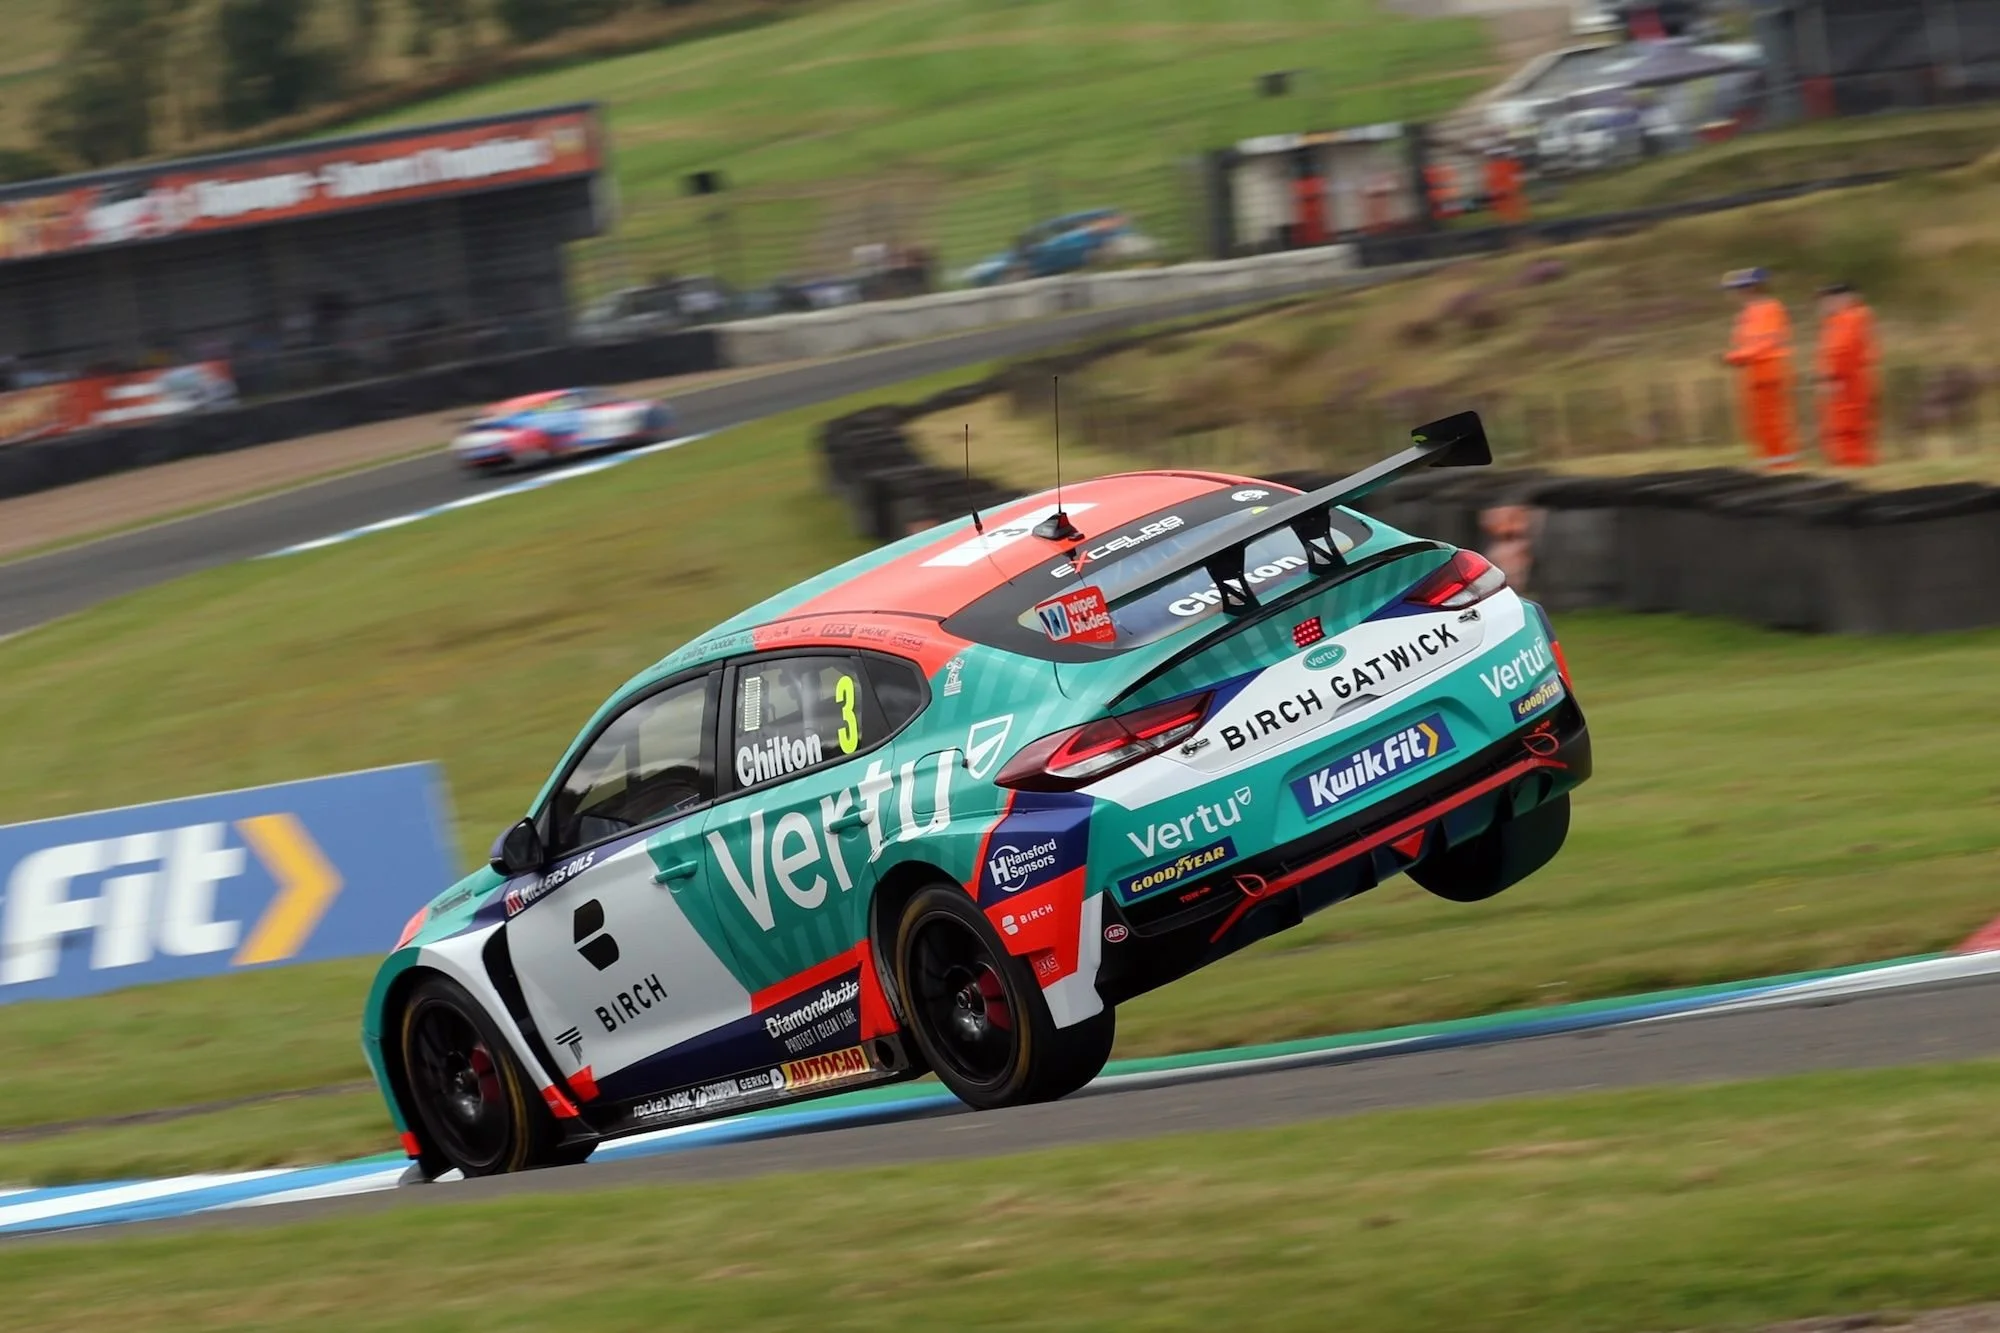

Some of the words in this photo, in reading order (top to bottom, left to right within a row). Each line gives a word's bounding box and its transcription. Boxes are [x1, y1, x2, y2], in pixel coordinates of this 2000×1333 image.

[1066, 594, 1098, 617] wiper
[1168, 556, 1308, 616] Chton
[1306, 648, 1335, 668] Vertu
[1479, 644, 1546, 698] Vertu
[1219, 688, 1324, 752] BIRCH
[1330, 622, 1460, 700] GATWICK
[836, 675, 859, 755] 3
[736, 733, 823, 787] Chilton
[705, 745, 957, 932] Vertu
[1006, 838, 1058, 866] Hansford
[1126, 801, 1242, 857] Vertu
[520, 868, 568, 904] MILLERS
[567, 851, 596, 880] OILS
[1009, 853, 1056, 879] Sensors
[1130, 846, 1226, 894] GOODYEAR
[1019, 903, 1054, 925] BIRCH
[1107, 926, 1126, 940] ABS
[595, 973, 668, 1033] BIRCH
[784, 1029, 816, 1055] PROTECT
[817, 1015, 841, 1039] CLEAN
[740, 1073, 770, 1090] GERKO
[789, 1048, 867, 1085] AUTOCAR
